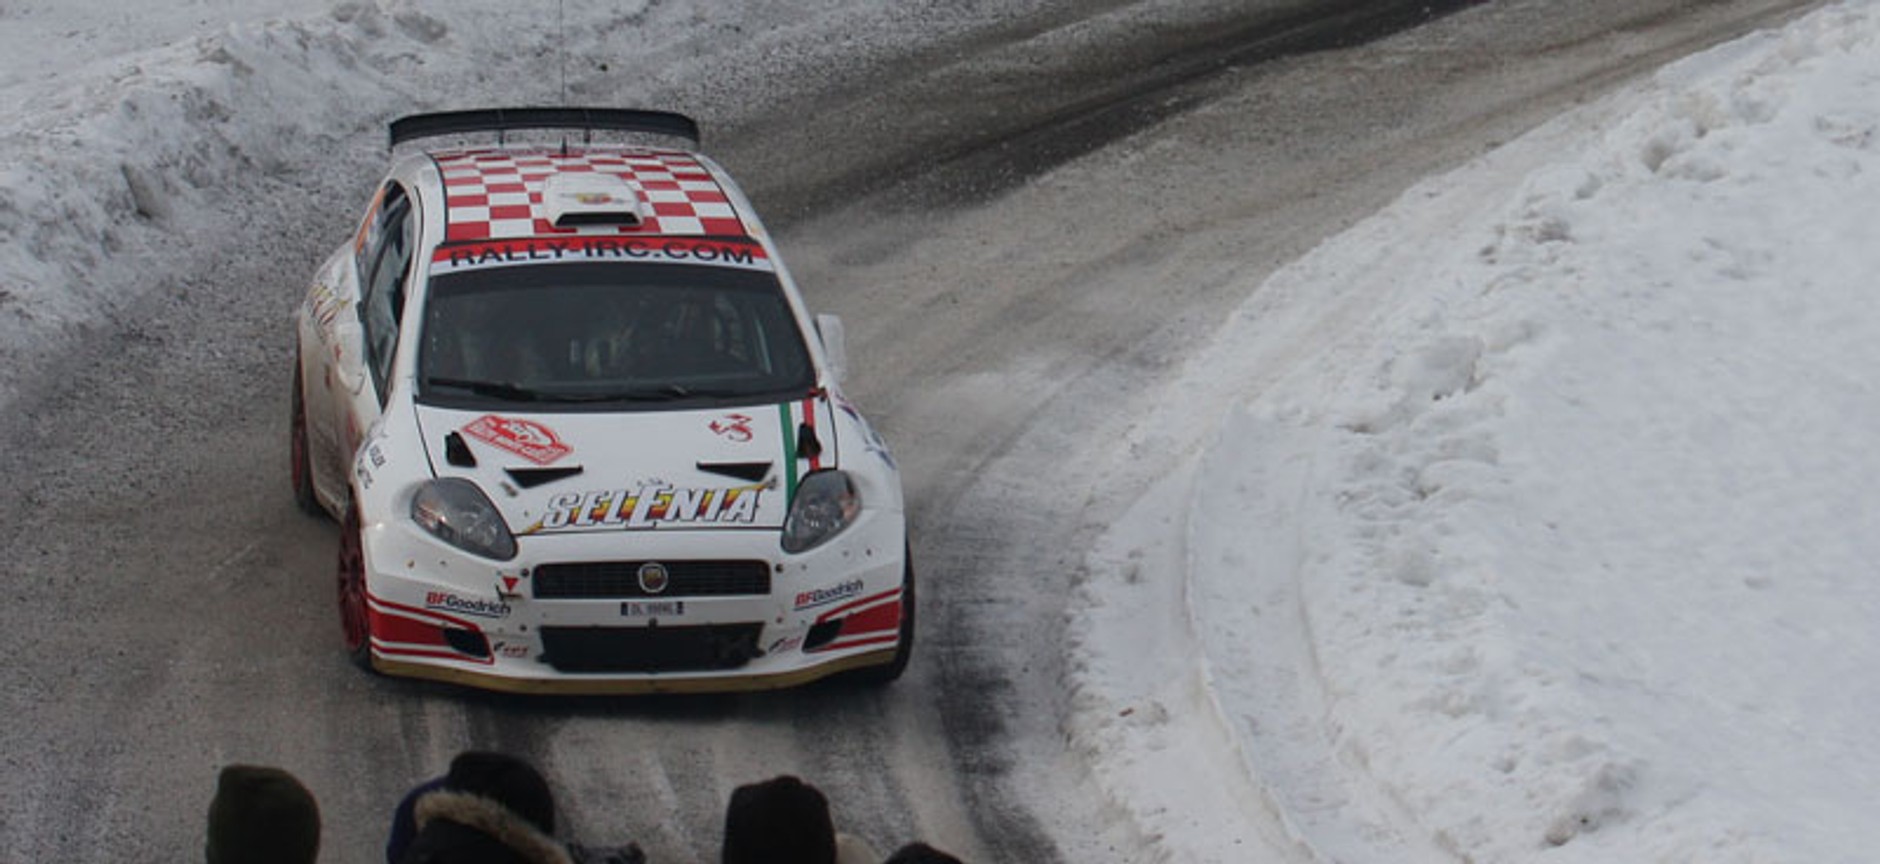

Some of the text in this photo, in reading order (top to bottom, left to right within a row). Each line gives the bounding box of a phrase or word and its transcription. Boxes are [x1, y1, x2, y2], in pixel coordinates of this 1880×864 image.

[451, 240, 755, 267] RALLY-IRC.COM
[543, 484, 762, 528] SELENIA
[426, 591, 511, 616] BFGoodrich
[795, 579, 864, 607] BFGoodrich
